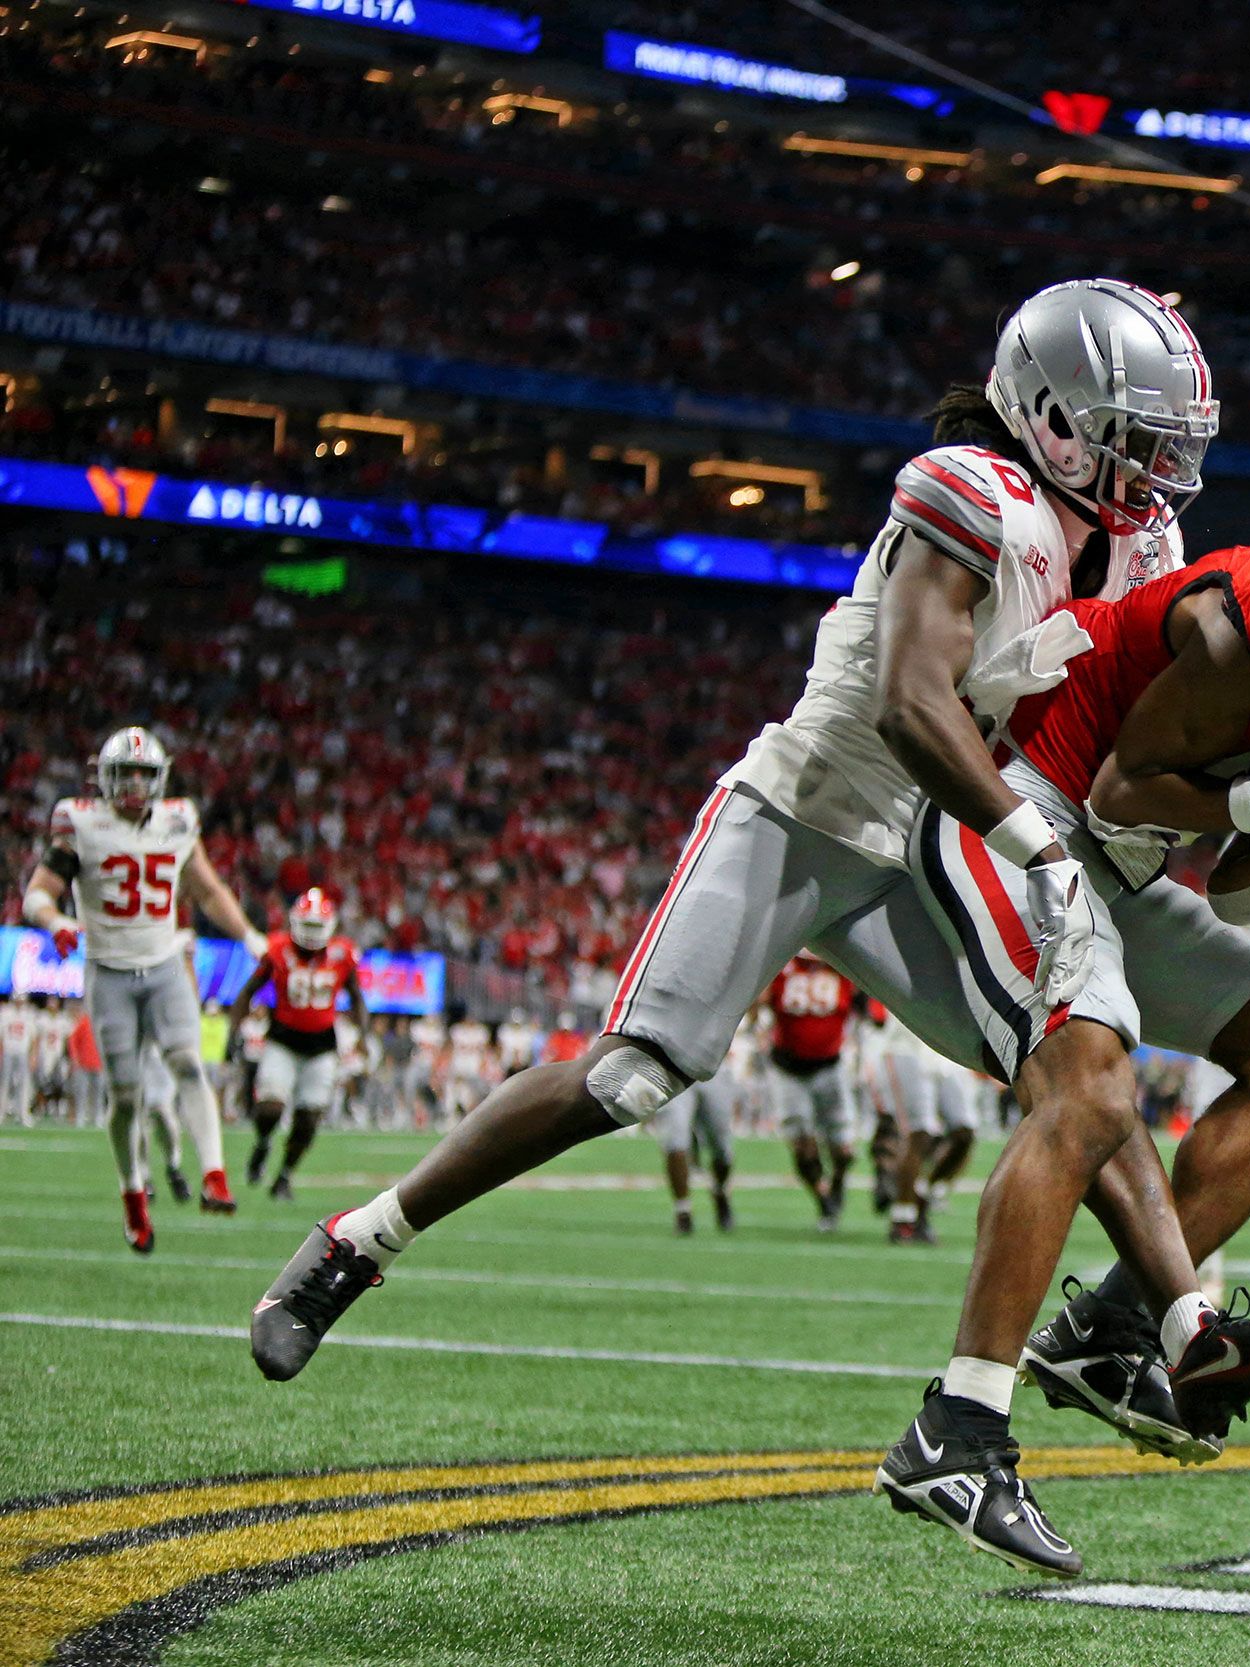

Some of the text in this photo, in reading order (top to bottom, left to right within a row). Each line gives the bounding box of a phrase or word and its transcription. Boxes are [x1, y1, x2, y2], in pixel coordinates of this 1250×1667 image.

[221, 488, 322, 529] DELTA
[101, 853, 177, 918] 35
[942, 1481, 969, 1506] ALPHA
